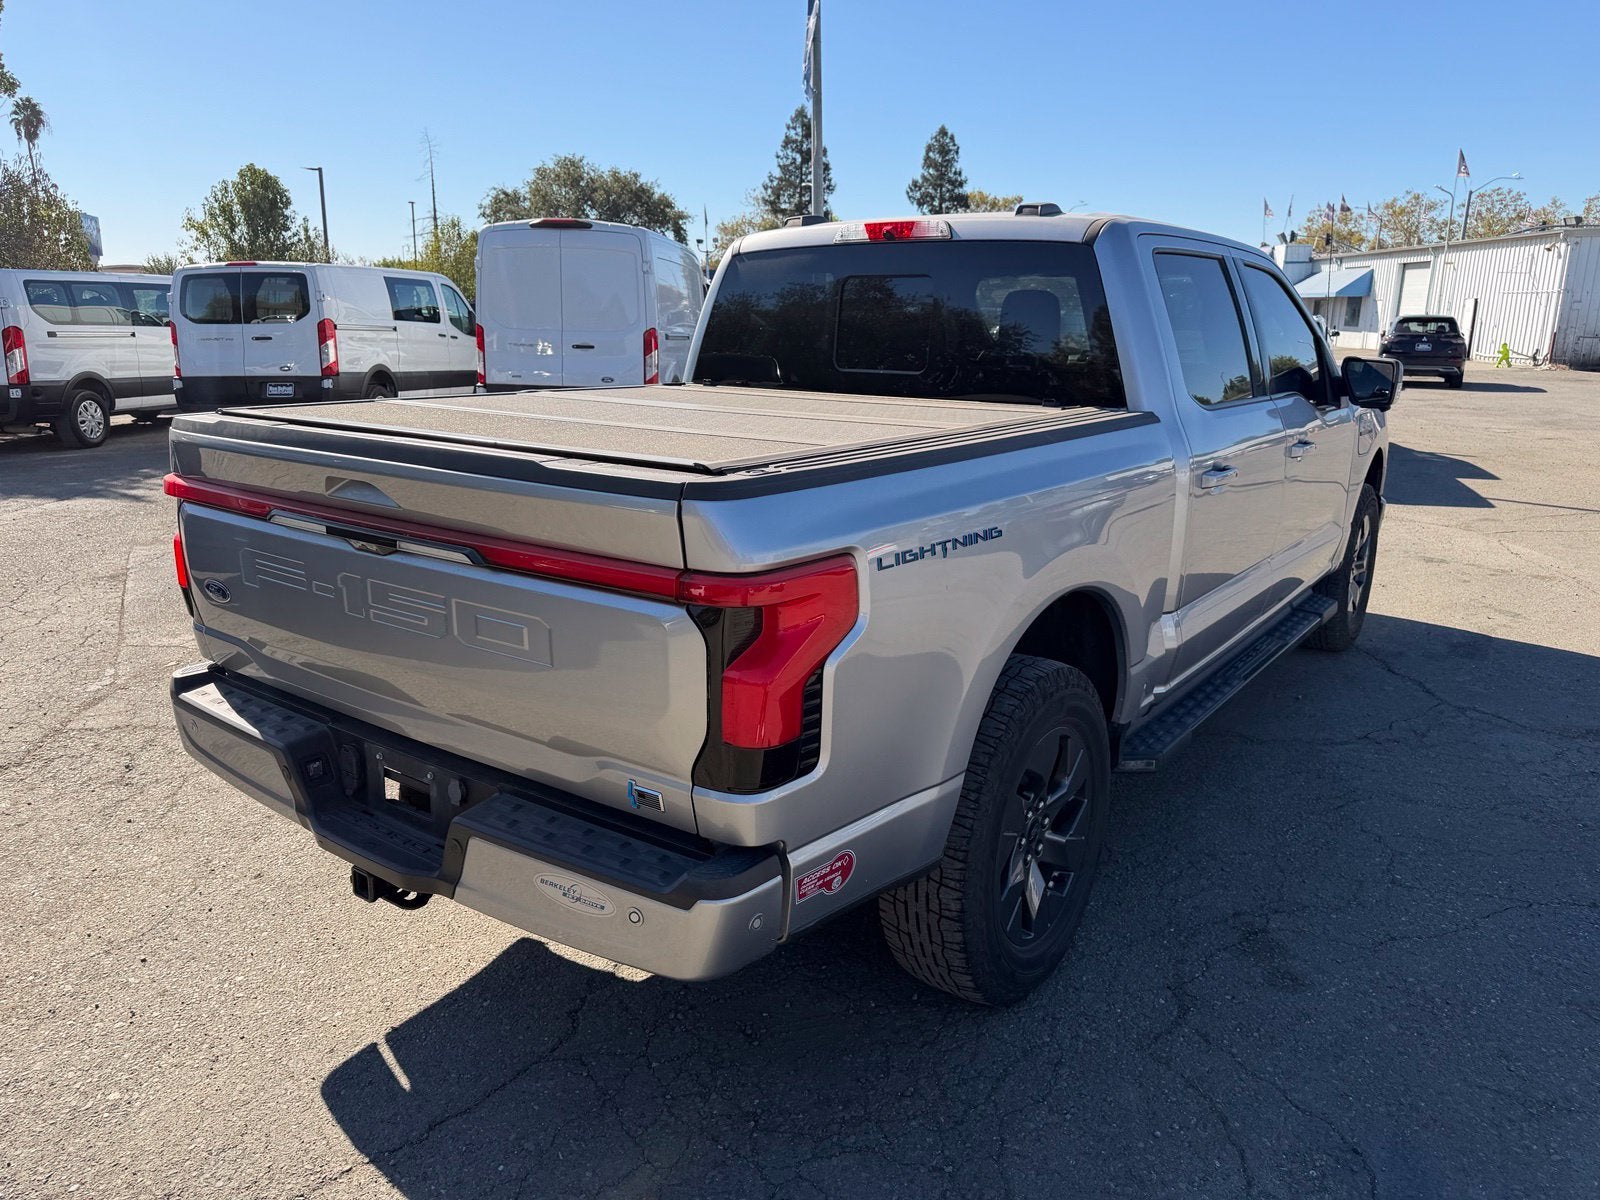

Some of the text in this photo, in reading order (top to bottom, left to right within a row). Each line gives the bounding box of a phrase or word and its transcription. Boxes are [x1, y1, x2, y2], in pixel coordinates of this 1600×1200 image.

[876, 526, 1003, 572] LIGHTNING
[239, 547, 554, 668] F-150
[540, 878, 577, 894] BERKELEY
[801, 866, 832, 885] ACCESS
